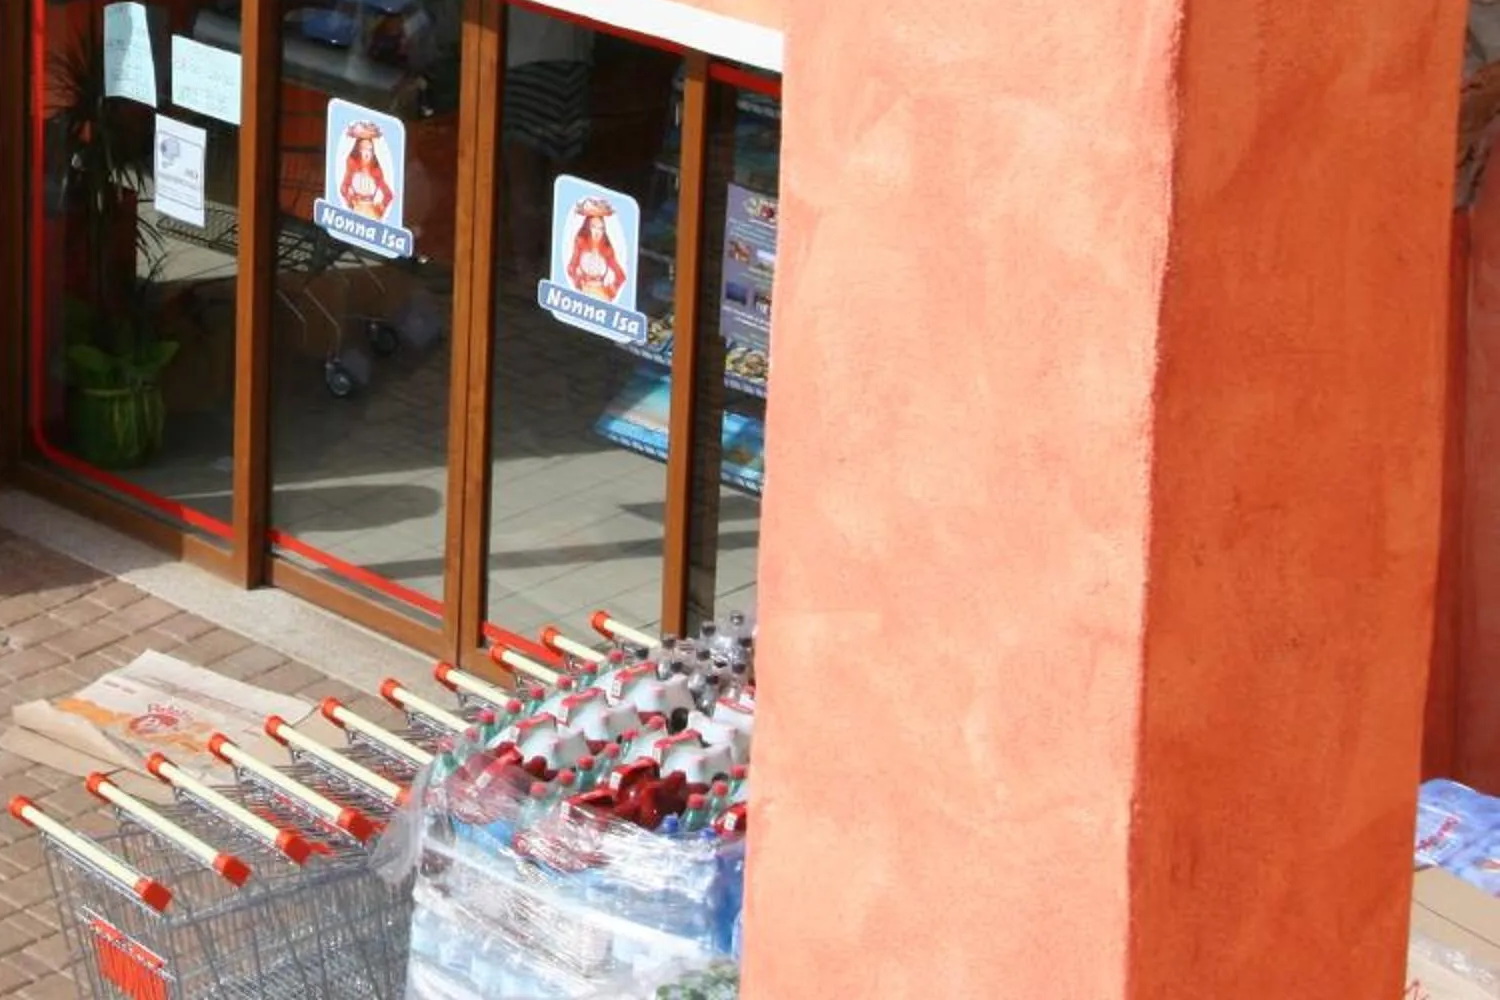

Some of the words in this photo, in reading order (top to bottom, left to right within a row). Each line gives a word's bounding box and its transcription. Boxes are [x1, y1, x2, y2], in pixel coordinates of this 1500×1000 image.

[322, 207, 376, 241] Nonna
[381, 229, 406, 251] Isa
[546, 287, 607, 325] Nonna
[612, 311, 639, 335] Isa
